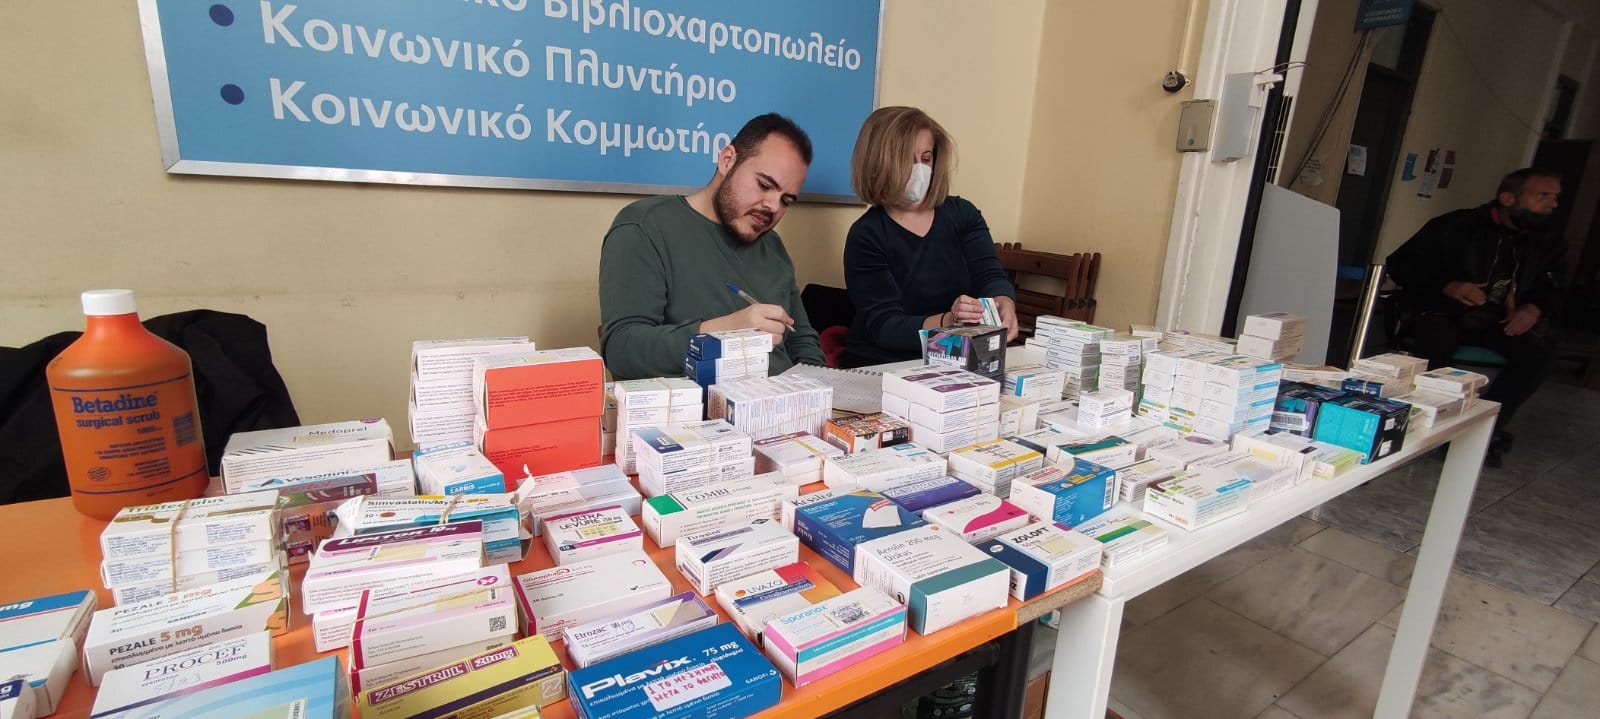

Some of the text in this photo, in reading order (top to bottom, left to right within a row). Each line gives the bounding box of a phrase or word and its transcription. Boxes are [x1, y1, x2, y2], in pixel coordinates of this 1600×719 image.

[260, 0, 737, 107] Κοινωνικό Πλυντήριο
[269, 77, 736, 164] Κοινωνικό Κομμωτήρ
[71, 391, 158, 414] Betadine
[76, 411, 161, 430] surgical scrub
[285, 470, 349, 483] Vesomni
[367, 498, 465, 507] Simvastatin/Myan
[686, 488, 730, 503] COMBI
[570, 512, 604, 522] ULTRA
[1011, 525, 1050, 545] ZOLOFT
[114, 599, 163, 616] PEZALE
[183, 587, 212, 600] mg
[780, 604, 829, 625] Sporanox
[109, 624, 204, 656] PEZALE 5 mg
[143, 644, 246, 681] PROCEF
[216, 653, 248, 666] 500mg
[581, 640, 739, 700] Plavix 75 mg
[374, 648, 515, 702] ZESTRIL 20mg
[745, 673, 768, 685] SANOFI
[654, 688, 679, 702] ΜΕΤΑ
[683, 681, 694, 691] ΤΟ
